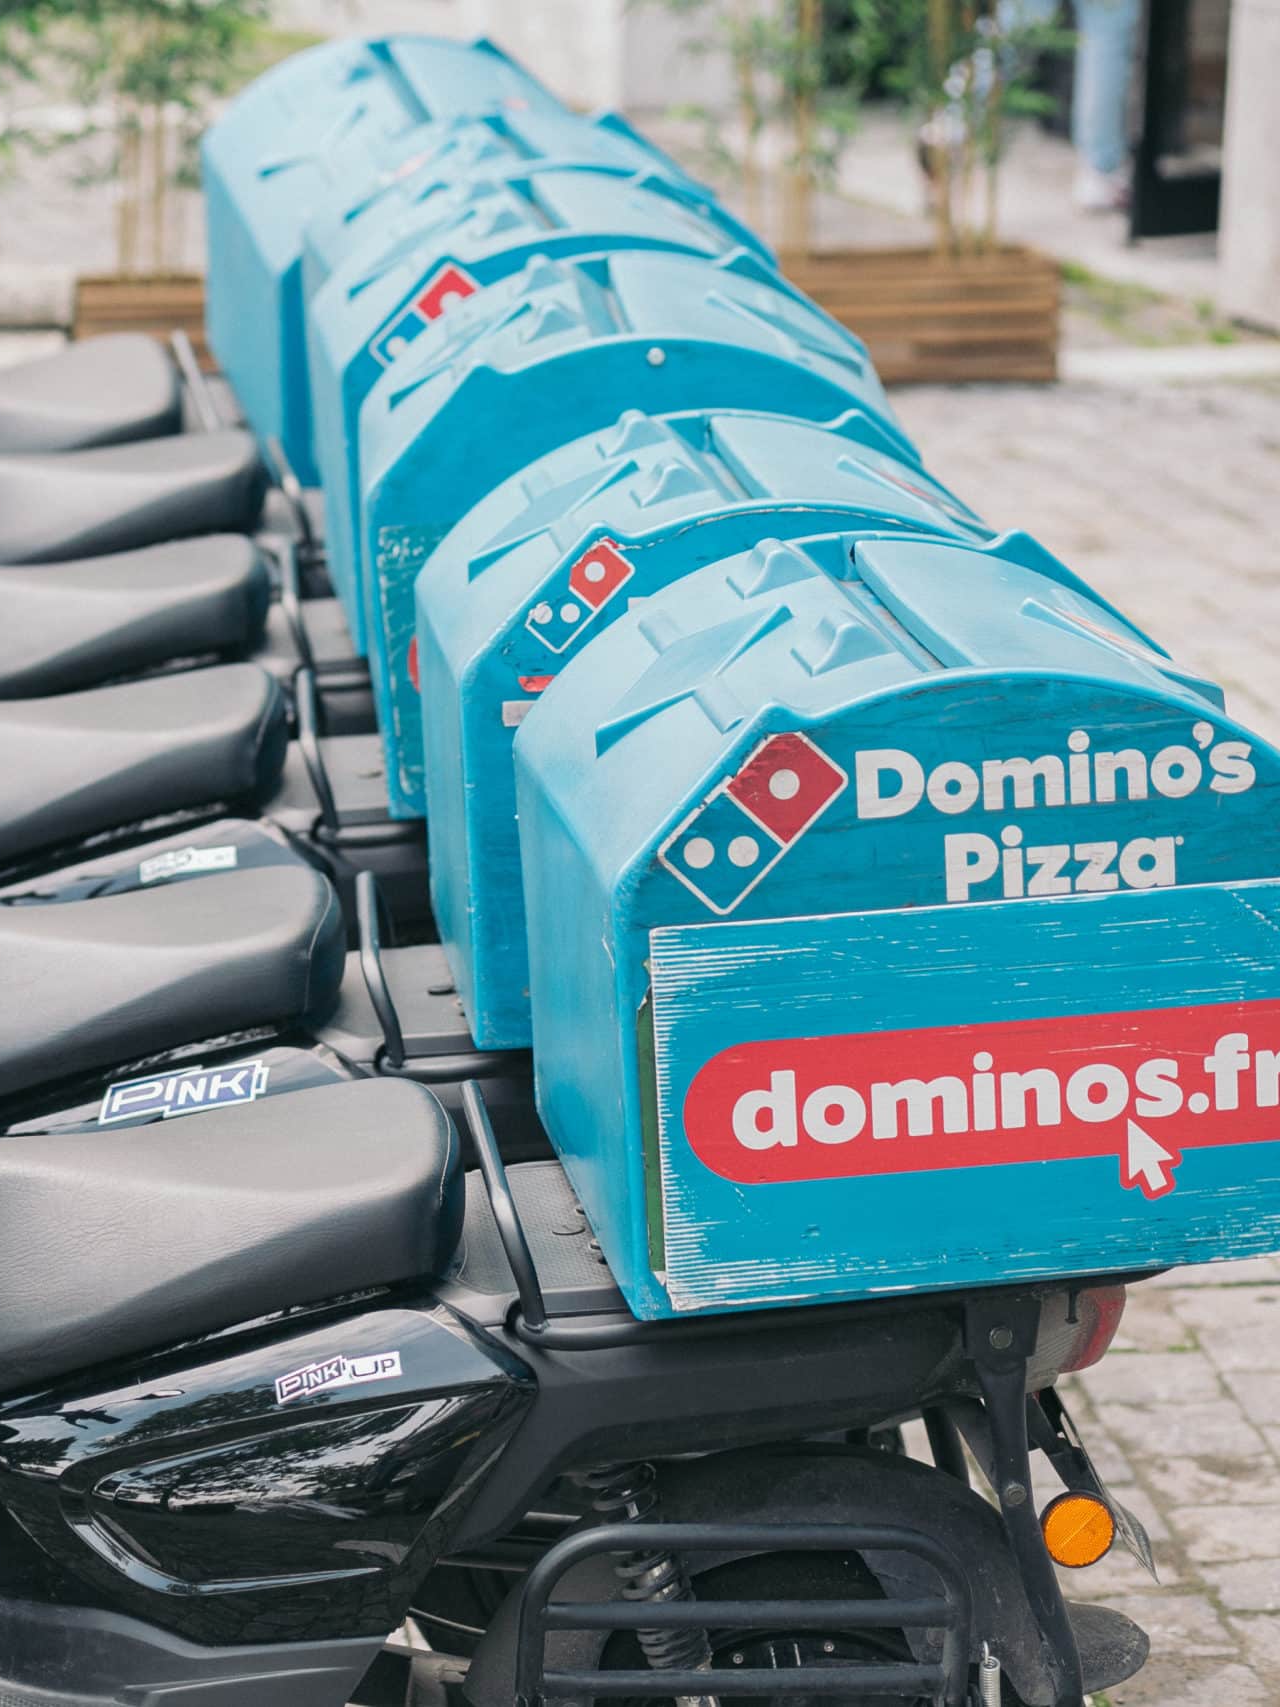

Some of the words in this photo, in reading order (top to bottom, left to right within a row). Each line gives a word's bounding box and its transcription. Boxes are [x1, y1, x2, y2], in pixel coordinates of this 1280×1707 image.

[943, 824, 1179, 902] Pizza
[109, 1068, 250, 1114] PINK
[731, 1031, 1280, 1151] dominos.fr
[279, 1361, 342, 1398] PINK
[351, 1357, 397, 1378] UP
